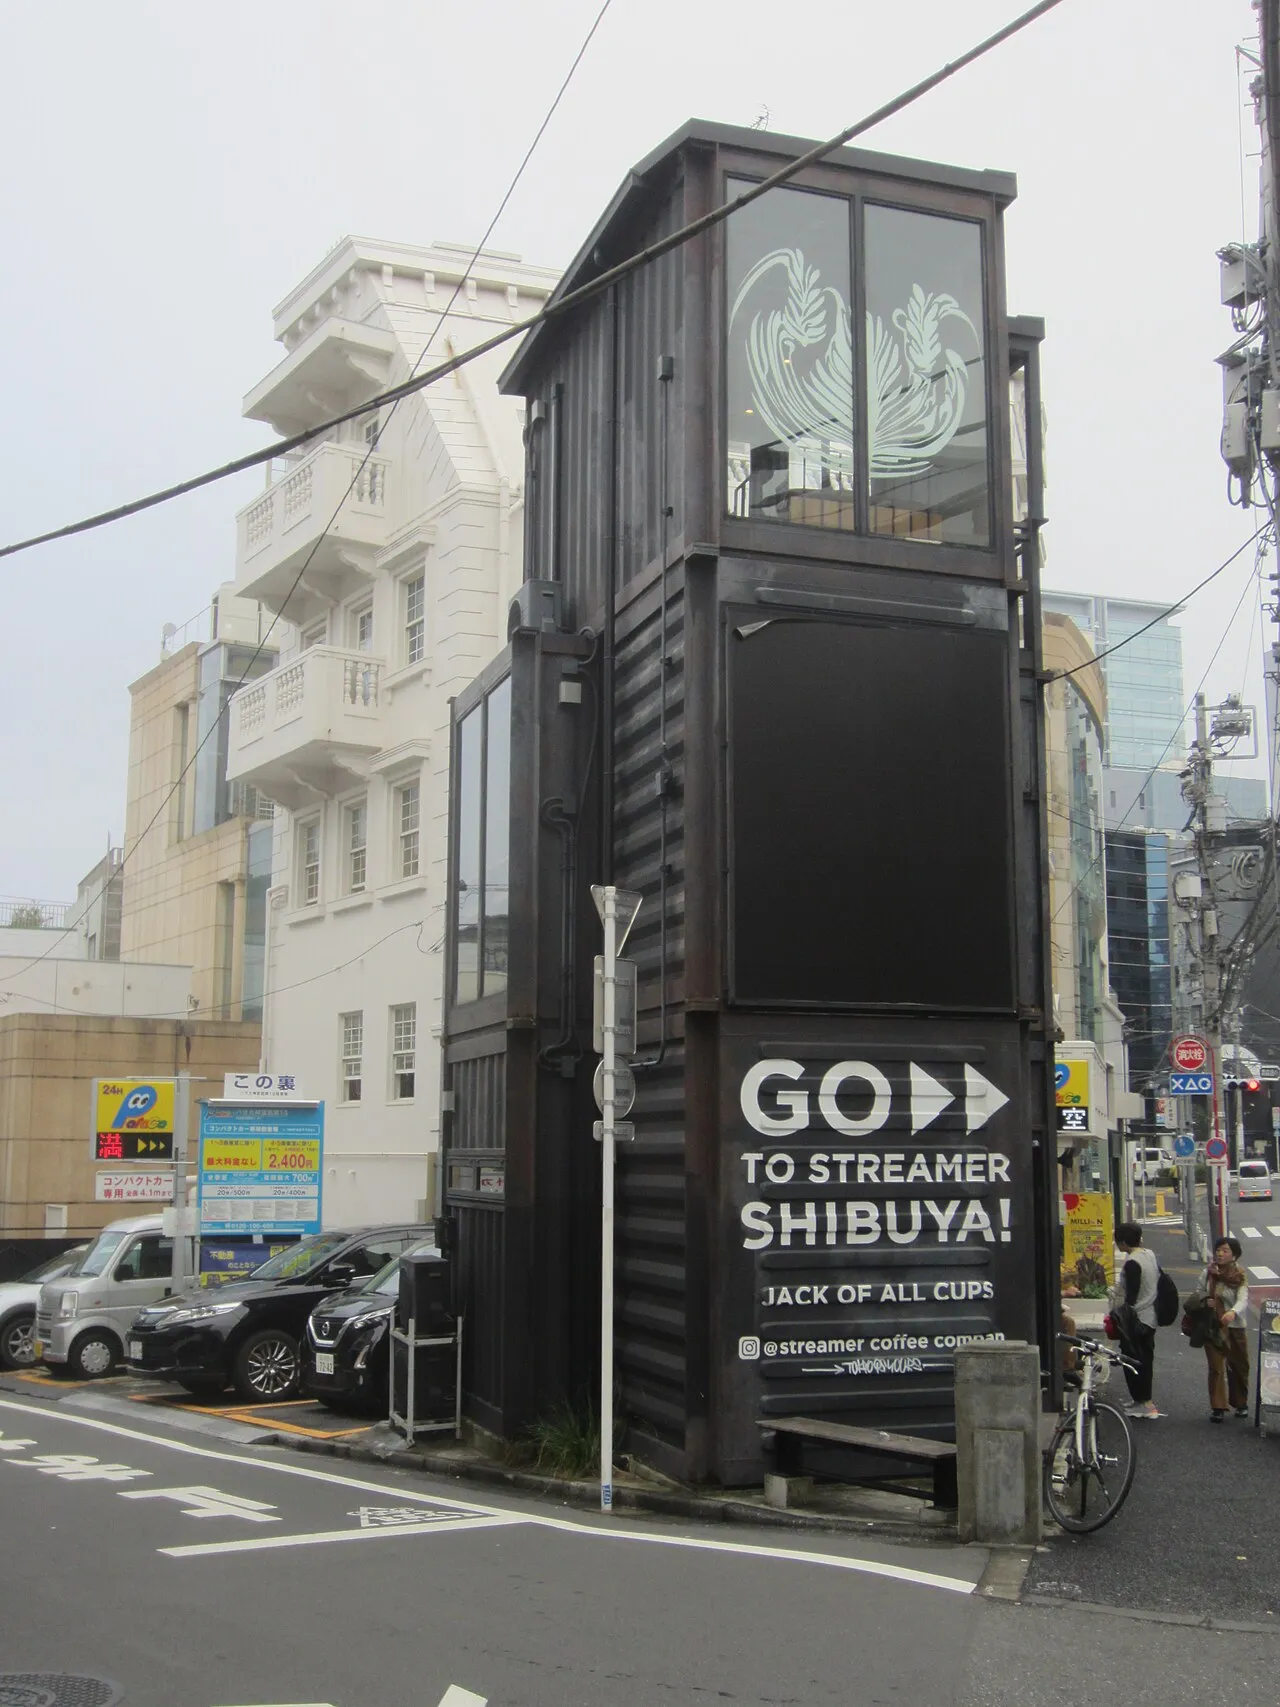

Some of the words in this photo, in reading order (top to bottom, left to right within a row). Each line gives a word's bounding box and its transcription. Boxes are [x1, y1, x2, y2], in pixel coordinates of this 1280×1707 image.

[1177, 1049, 1203, 1060] 消火栓
[102, 1085, 123, 1095] 24H
[234, 1075, 296, 1091] この裏
[740, 1058, 892, 1137] GO
[1062, 1107, 1087, 1130] 空
[99, 1133, 123, 1158] 満
[740, 1153, 795, 1183] TO
[808, 1153, 1011, 1183] STREAMER
[103, 1177, 173, 1187] コンパクトカー
[103, 1189, 124, 1198] 専用
[740, 1199, 1011, 1250] SHIBUYA!
[761, 1286, 829, 1307] JACK
[837, 1284, 873, 1304] OF
[880, 1283, 926, 1303] ALL
[933, 1281, 995, 1301] CUPS
[763, 1337, 865, 1357] @streamer
[870, 1333, 929, 1351] coffee
[1264, 1359, 1280, 1369] LA
